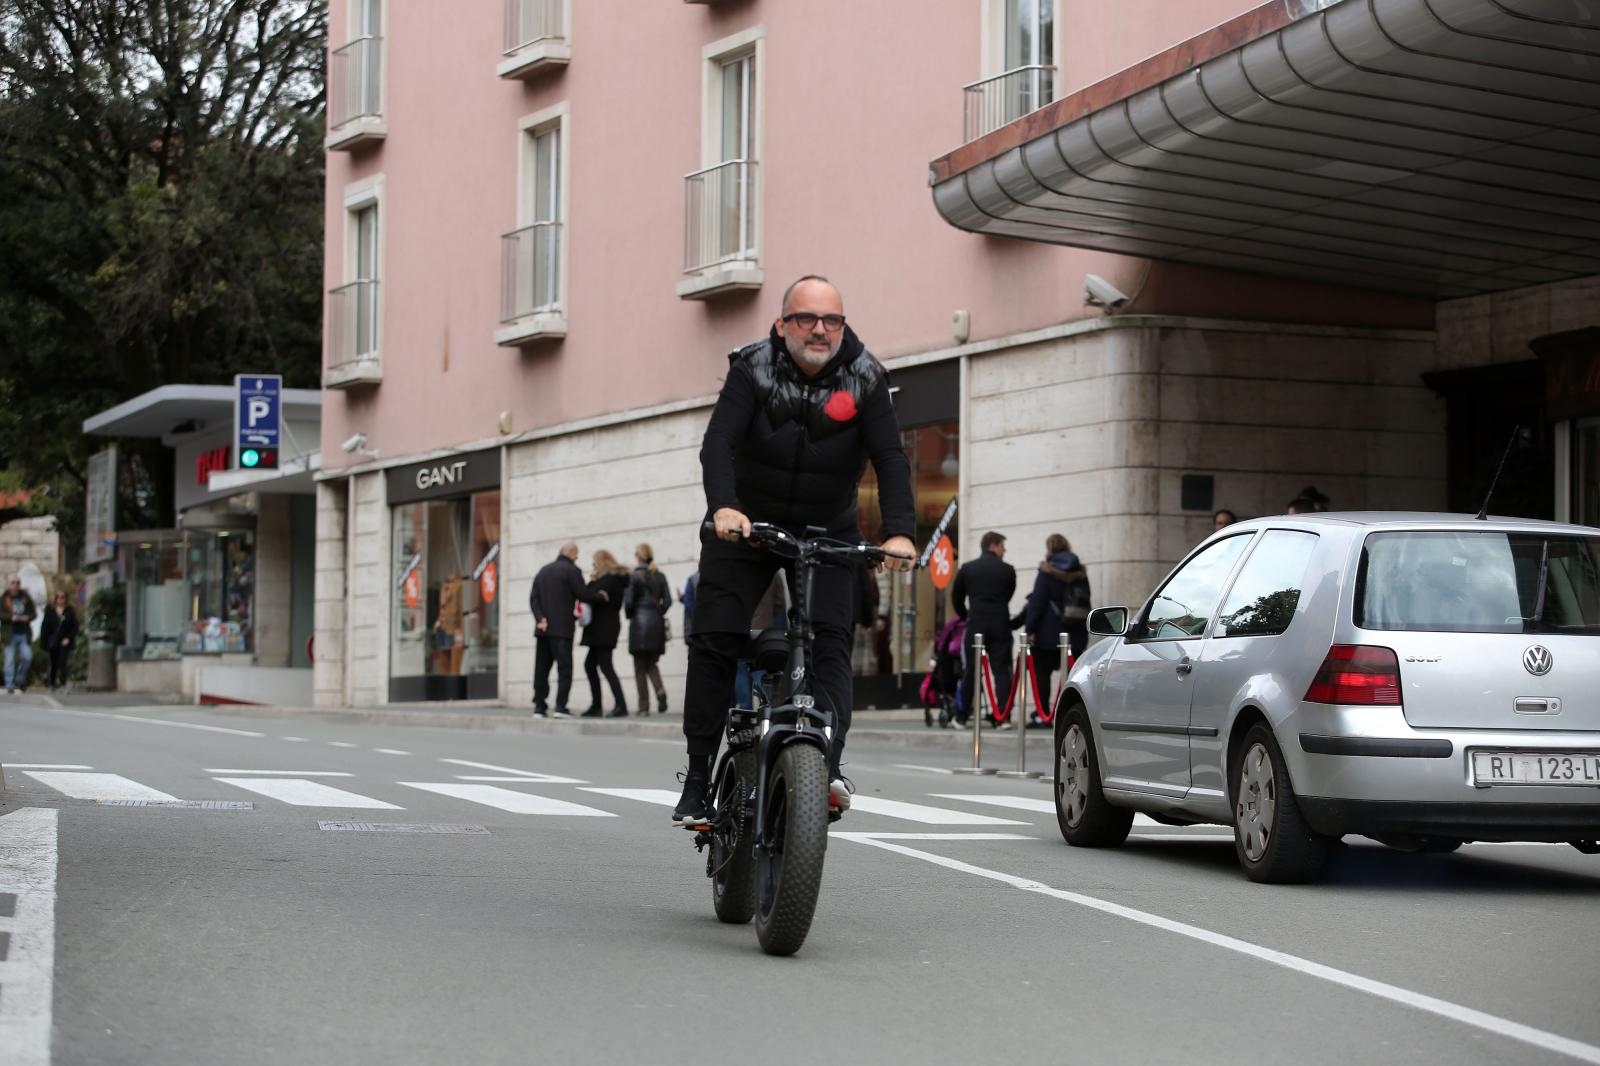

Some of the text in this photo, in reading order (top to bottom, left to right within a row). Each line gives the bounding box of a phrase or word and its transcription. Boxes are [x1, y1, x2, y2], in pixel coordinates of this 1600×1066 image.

[248, 400, 270, 427] P
[416, 461, 467, 489] GANT
[933, 547, 950, 576] %
[1491, 756, 1514, 779] RI
